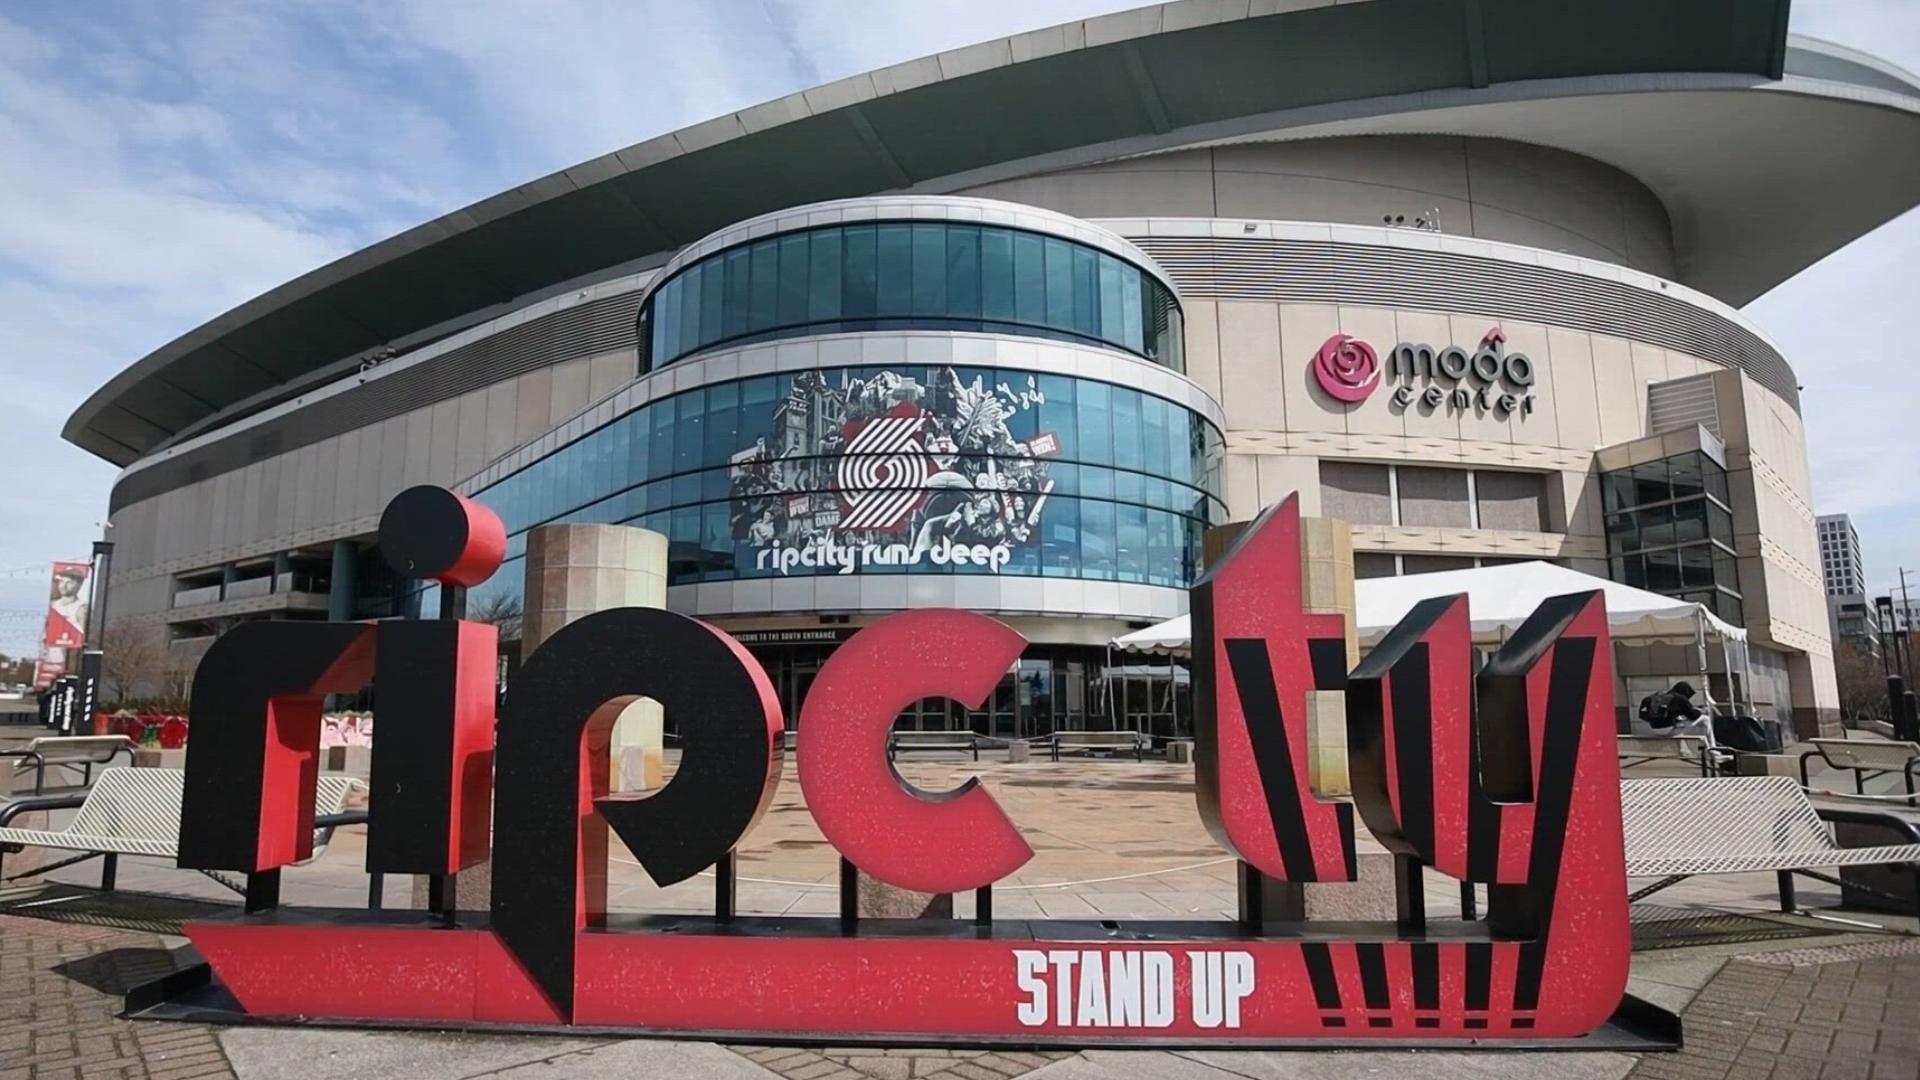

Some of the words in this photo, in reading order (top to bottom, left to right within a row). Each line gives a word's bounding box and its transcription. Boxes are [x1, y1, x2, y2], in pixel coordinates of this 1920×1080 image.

[1395, 328, 1534, 387] moda
[1395, 386, 1536, 414] center
[930, 535, 1011, 574] deep
[781, 632, 801, 641] SOUTH
[803, 631, 836, 640] ENTRANCE
[1012, 950, 1175, 1028] STAND
[1186, 951, 1255, 1028] UP
